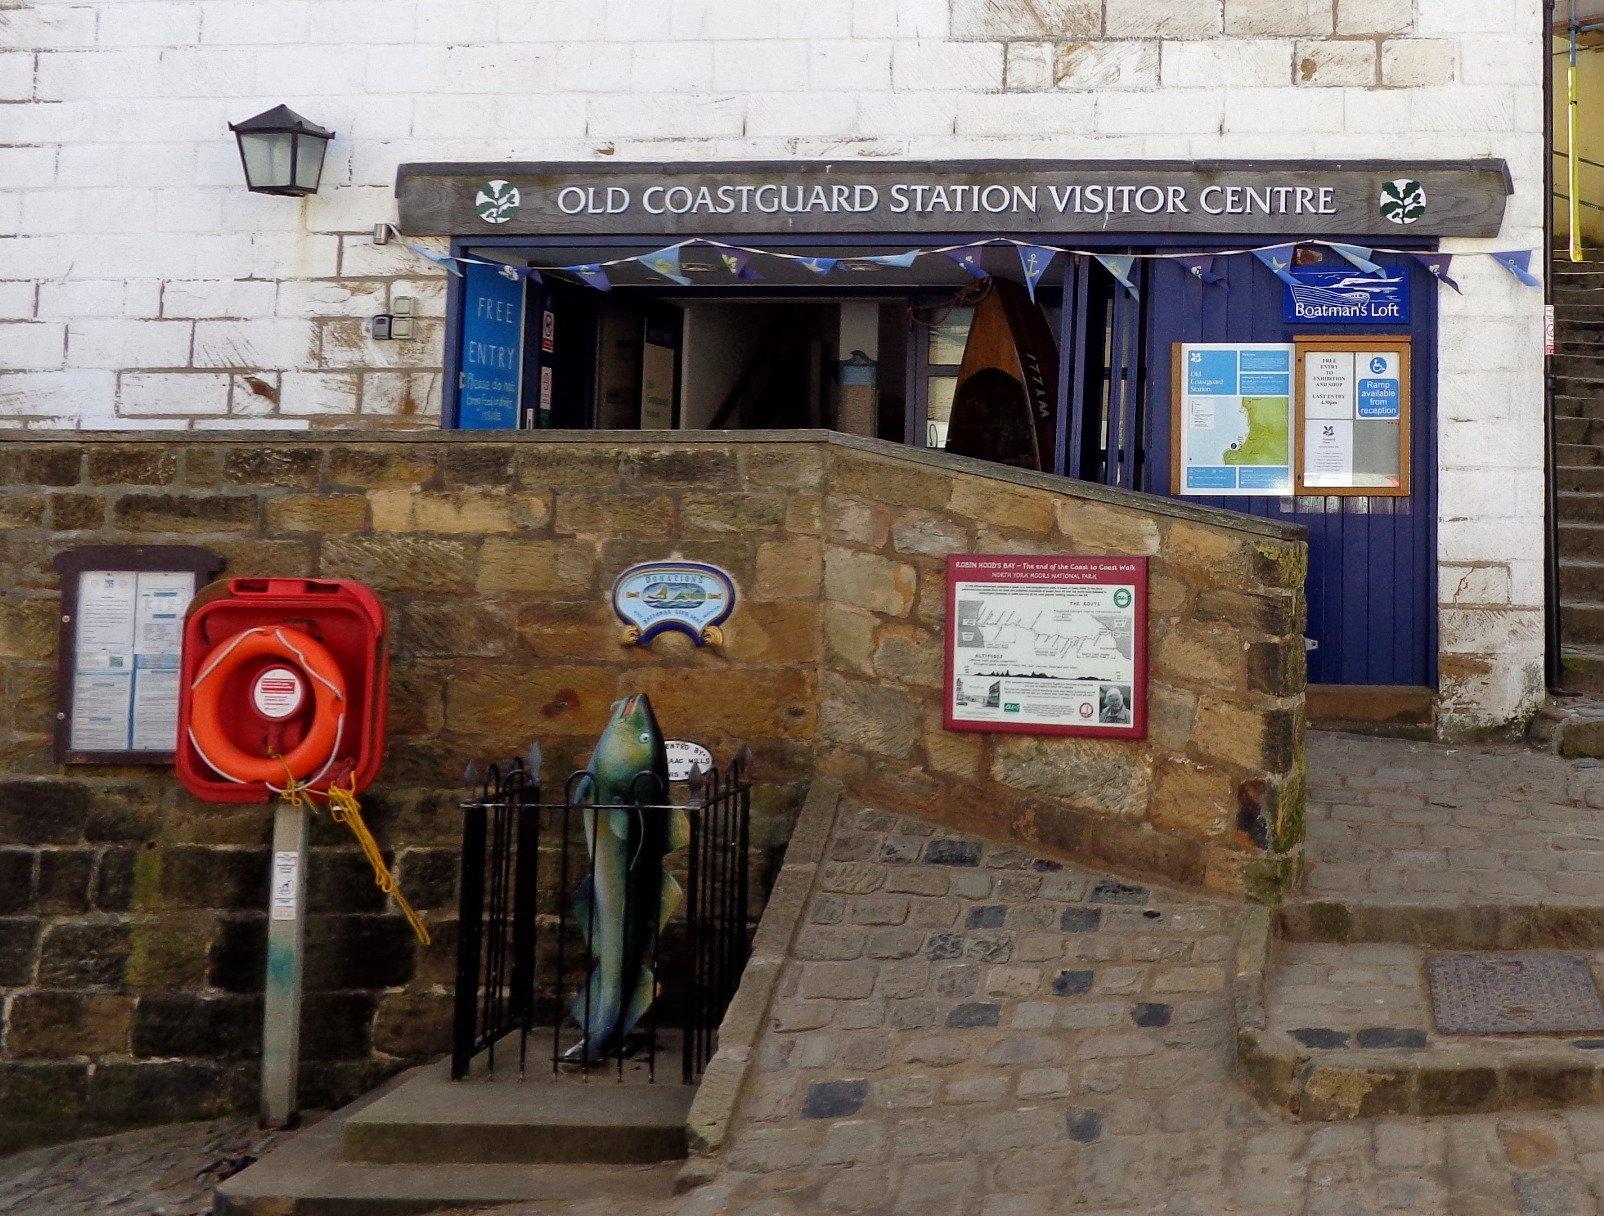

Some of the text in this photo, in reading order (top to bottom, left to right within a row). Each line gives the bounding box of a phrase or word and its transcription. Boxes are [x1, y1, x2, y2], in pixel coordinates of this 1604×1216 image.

[557, 184, 1337, 215] OLD COASTGUARD STATION VISITOR CENTRE
[477, 297, 514, 324] FREE
[1295, 303, 1400, 317] Boatman's Loft
[469, 340, 516, 370] ENTRY
[1366, 381, 1390, 390] Ramp
[1361, 389, 1396, 397] available
[1360, 407, 1397, 415] reception
[1003, 562, 1016, 570] BAY
[645, 575, 704, 584] DONATIONS
